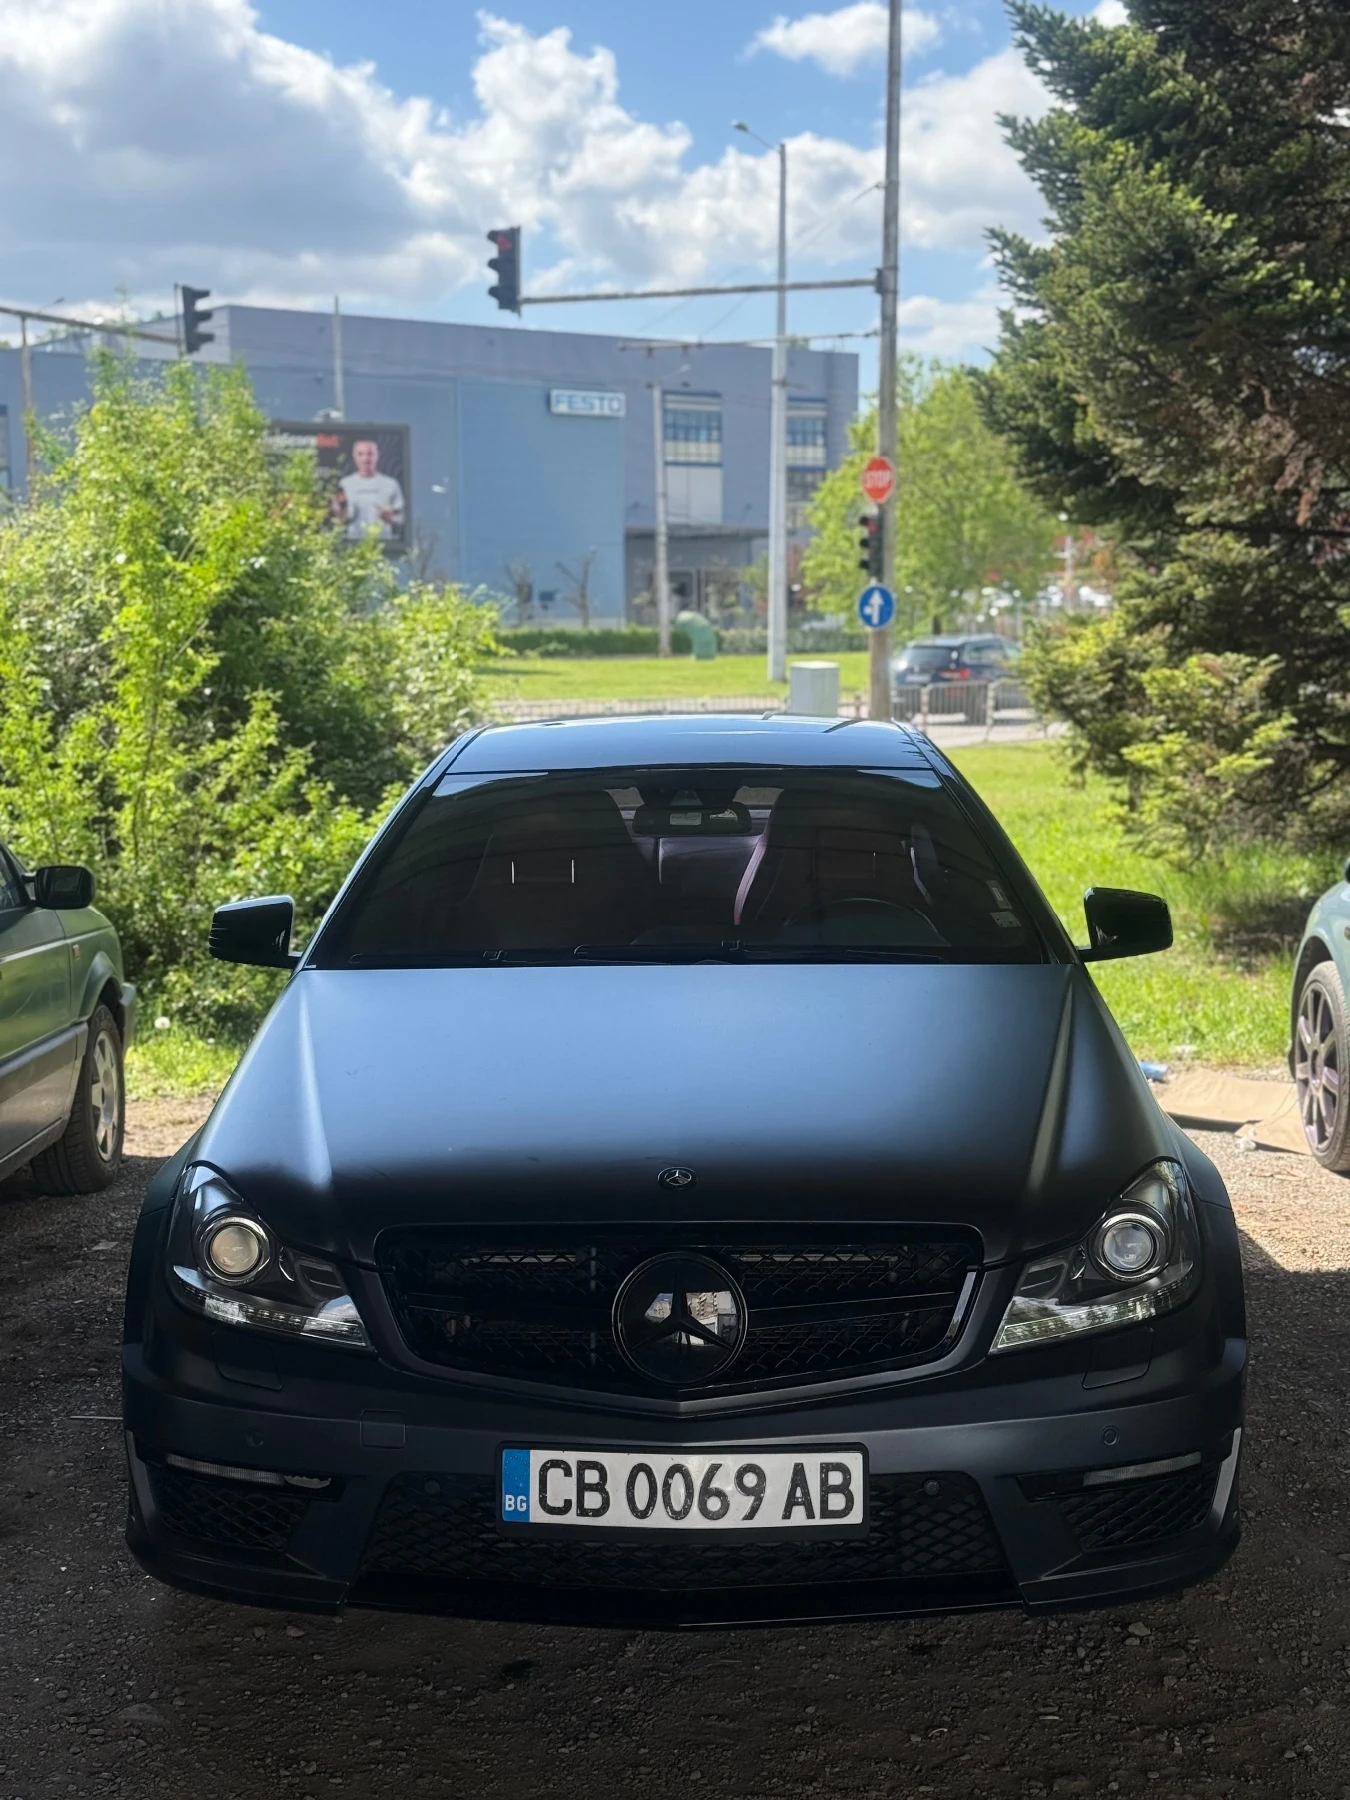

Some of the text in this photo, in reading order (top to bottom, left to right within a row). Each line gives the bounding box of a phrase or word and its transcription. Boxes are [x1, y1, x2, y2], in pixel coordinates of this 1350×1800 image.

[555, 394, 621, 413] FESTO
[865, 470, 892, 488] STOP
[538, 1459, 855, 1521] CB 0069 AB
[504, 1494, 527, 1512] BG
